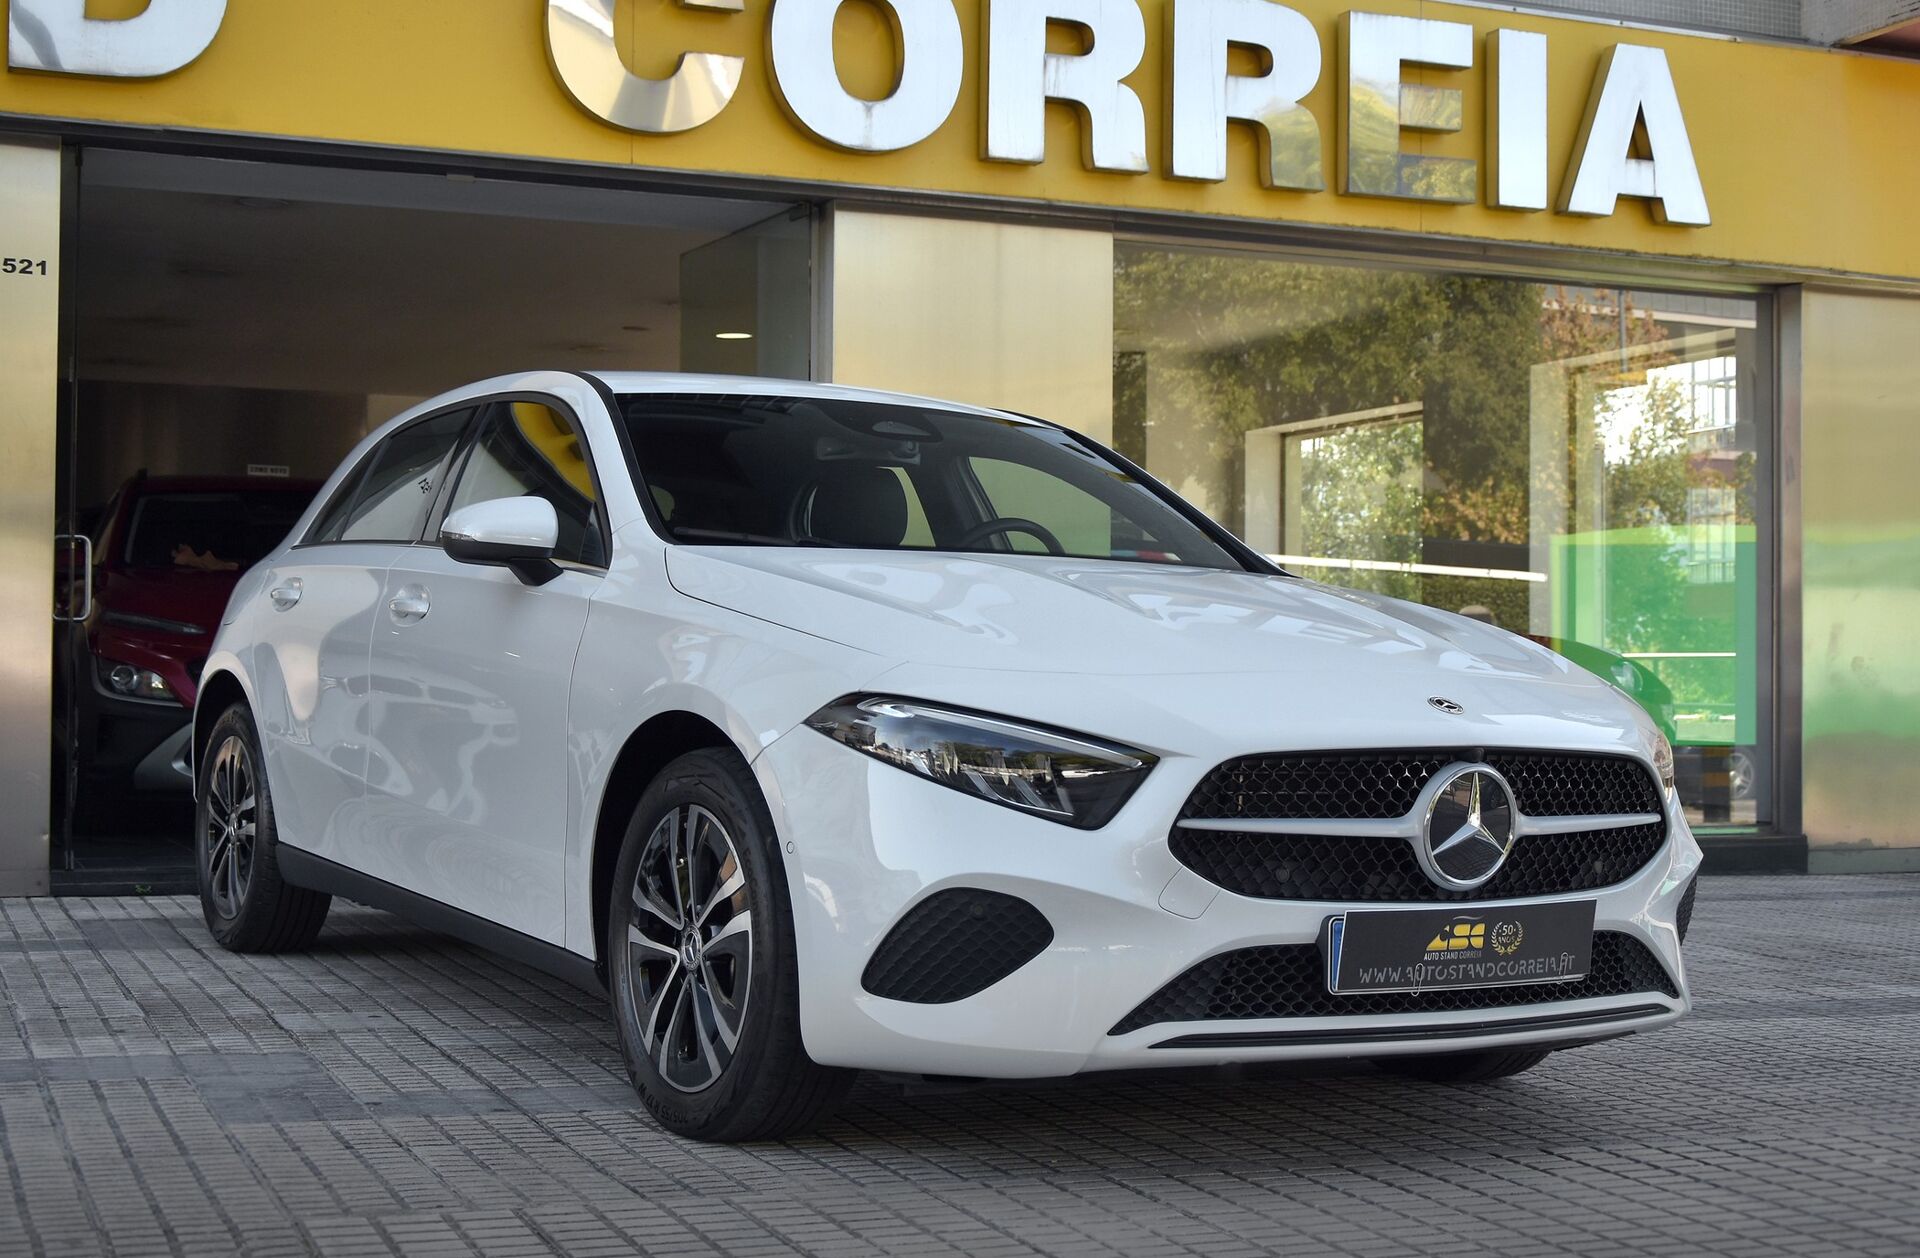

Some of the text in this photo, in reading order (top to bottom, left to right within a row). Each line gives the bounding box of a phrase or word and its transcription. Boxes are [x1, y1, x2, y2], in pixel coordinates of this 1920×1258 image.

[544, 0, 1711, 227] CORREIA
[2, 257, 47, 276] 521
[1502, 924, 1514, 935] 50
[1423, 950, 1482, 961] AUTO STAND CORREIA
